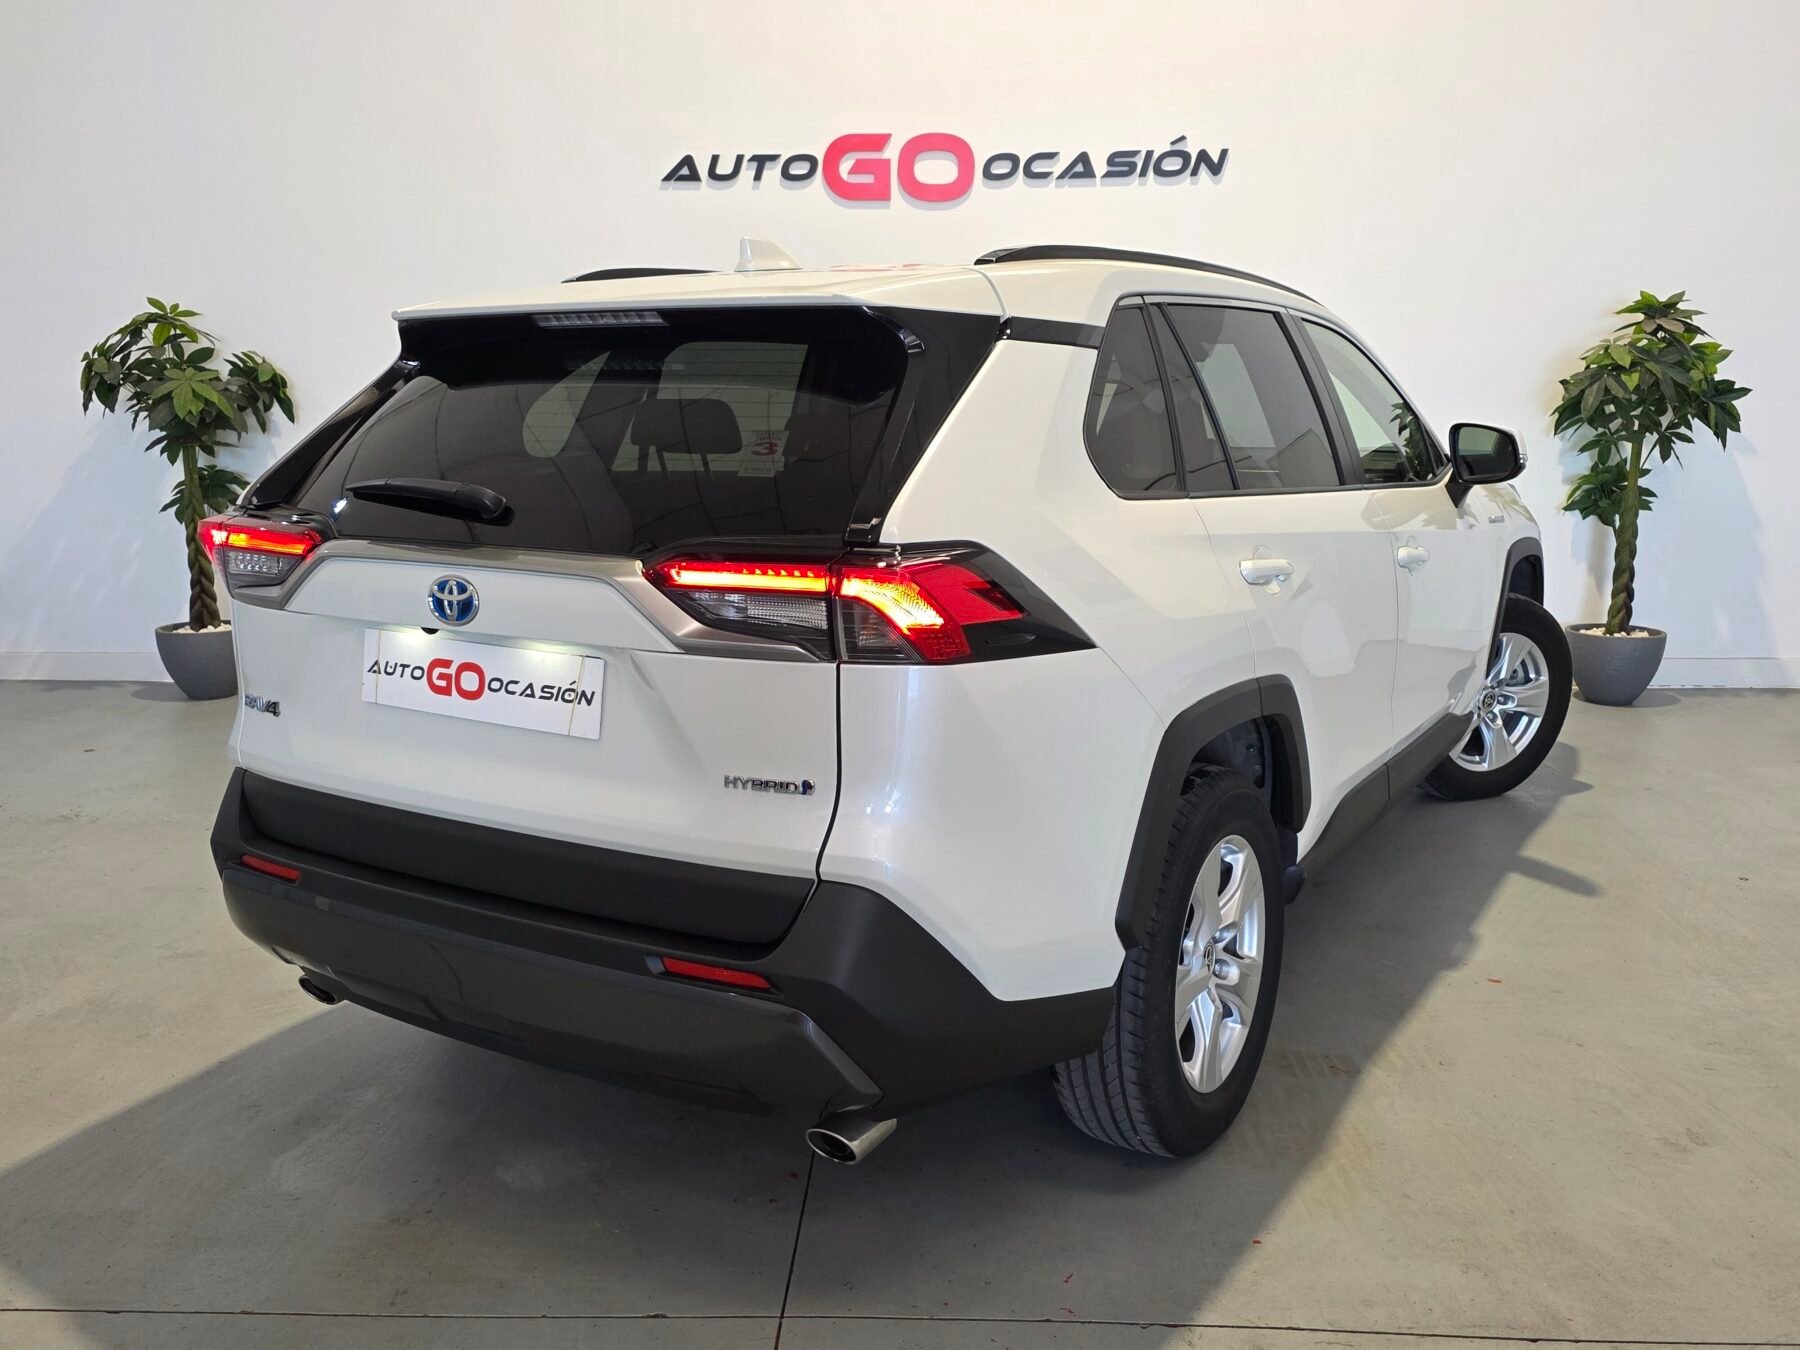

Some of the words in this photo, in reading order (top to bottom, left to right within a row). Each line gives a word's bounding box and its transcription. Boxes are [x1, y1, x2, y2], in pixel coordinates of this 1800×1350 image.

[661, 154, 818, 182] AUTO
[822, 132, 976, 202] GO
[981, 135, 1230, 180] OCASIÓN
[367, 659, 425, 681] AUTO
[426, 657, 486, 701] GO
[487, 676, 596, 707] OCASIÓN
[724, 774, 801, 794] HYBRID
